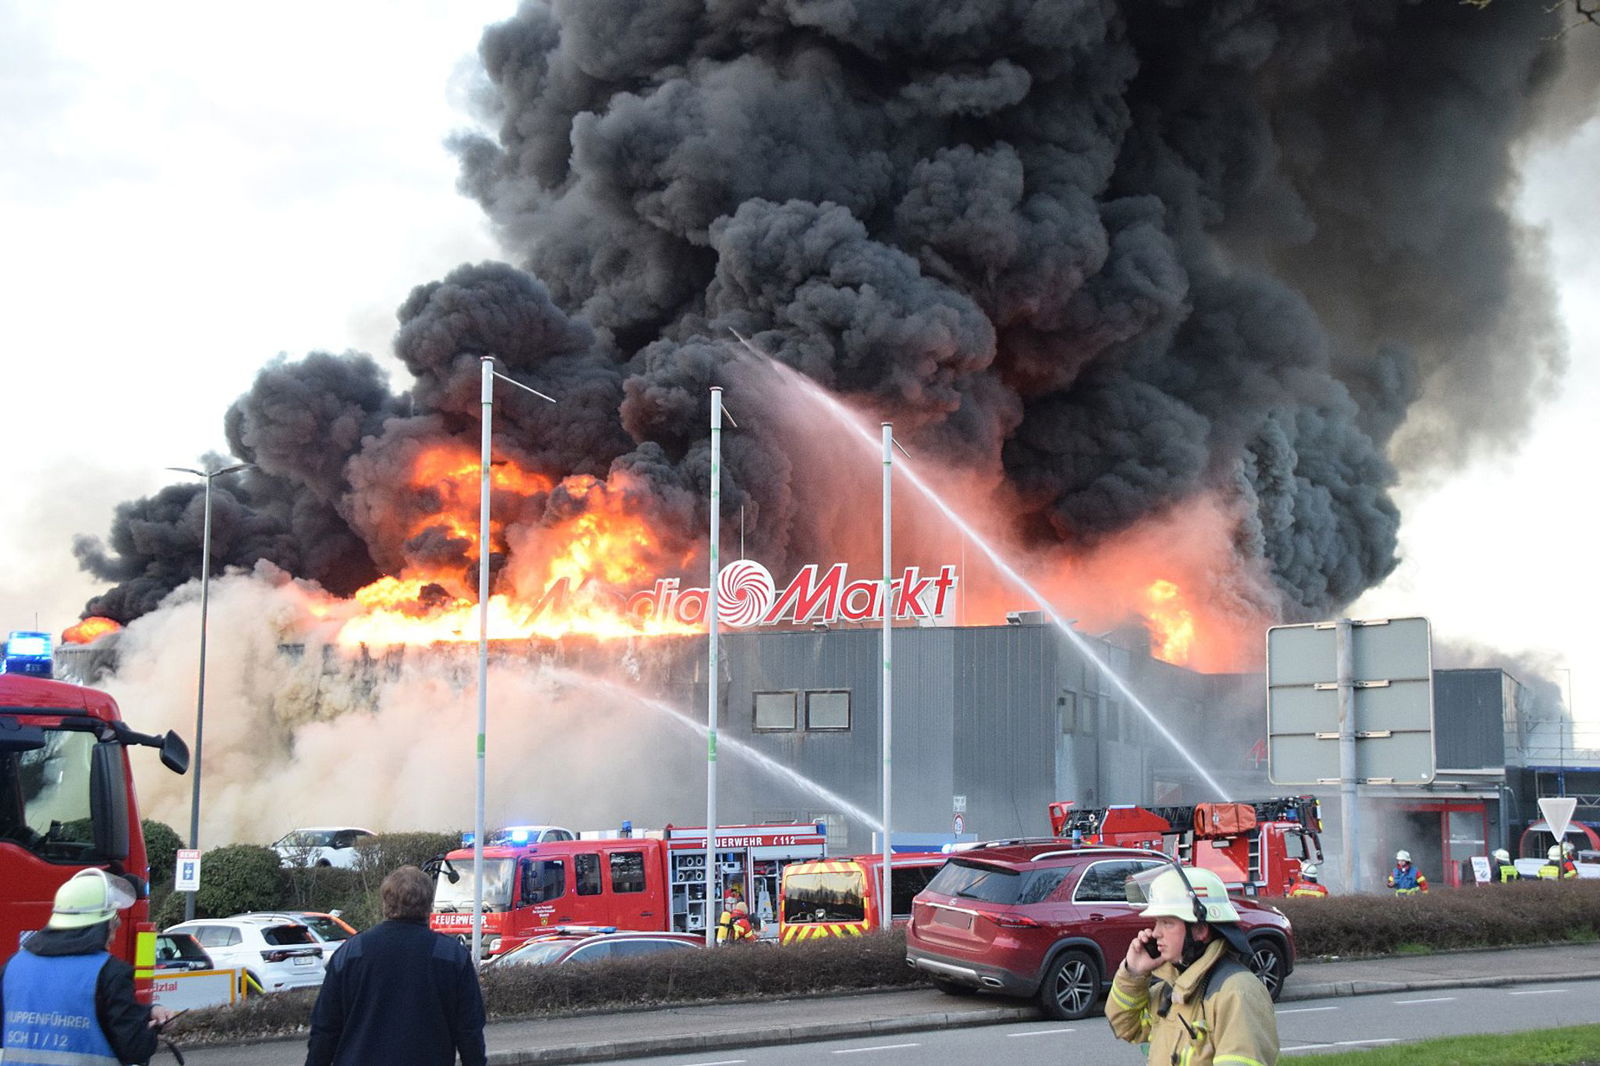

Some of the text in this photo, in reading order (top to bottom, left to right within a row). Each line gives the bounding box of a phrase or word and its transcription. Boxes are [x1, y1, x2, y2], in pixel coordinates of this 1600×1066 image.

[519, 563, 958, 628] Mdia Markt
[702, 836, 795, 848] FUERWEHR 112
[435, 915, 487, 925] FEUERWER
[8, 1031, 29, 1044] SCH
[53, 1034, 69, 1047] 12
